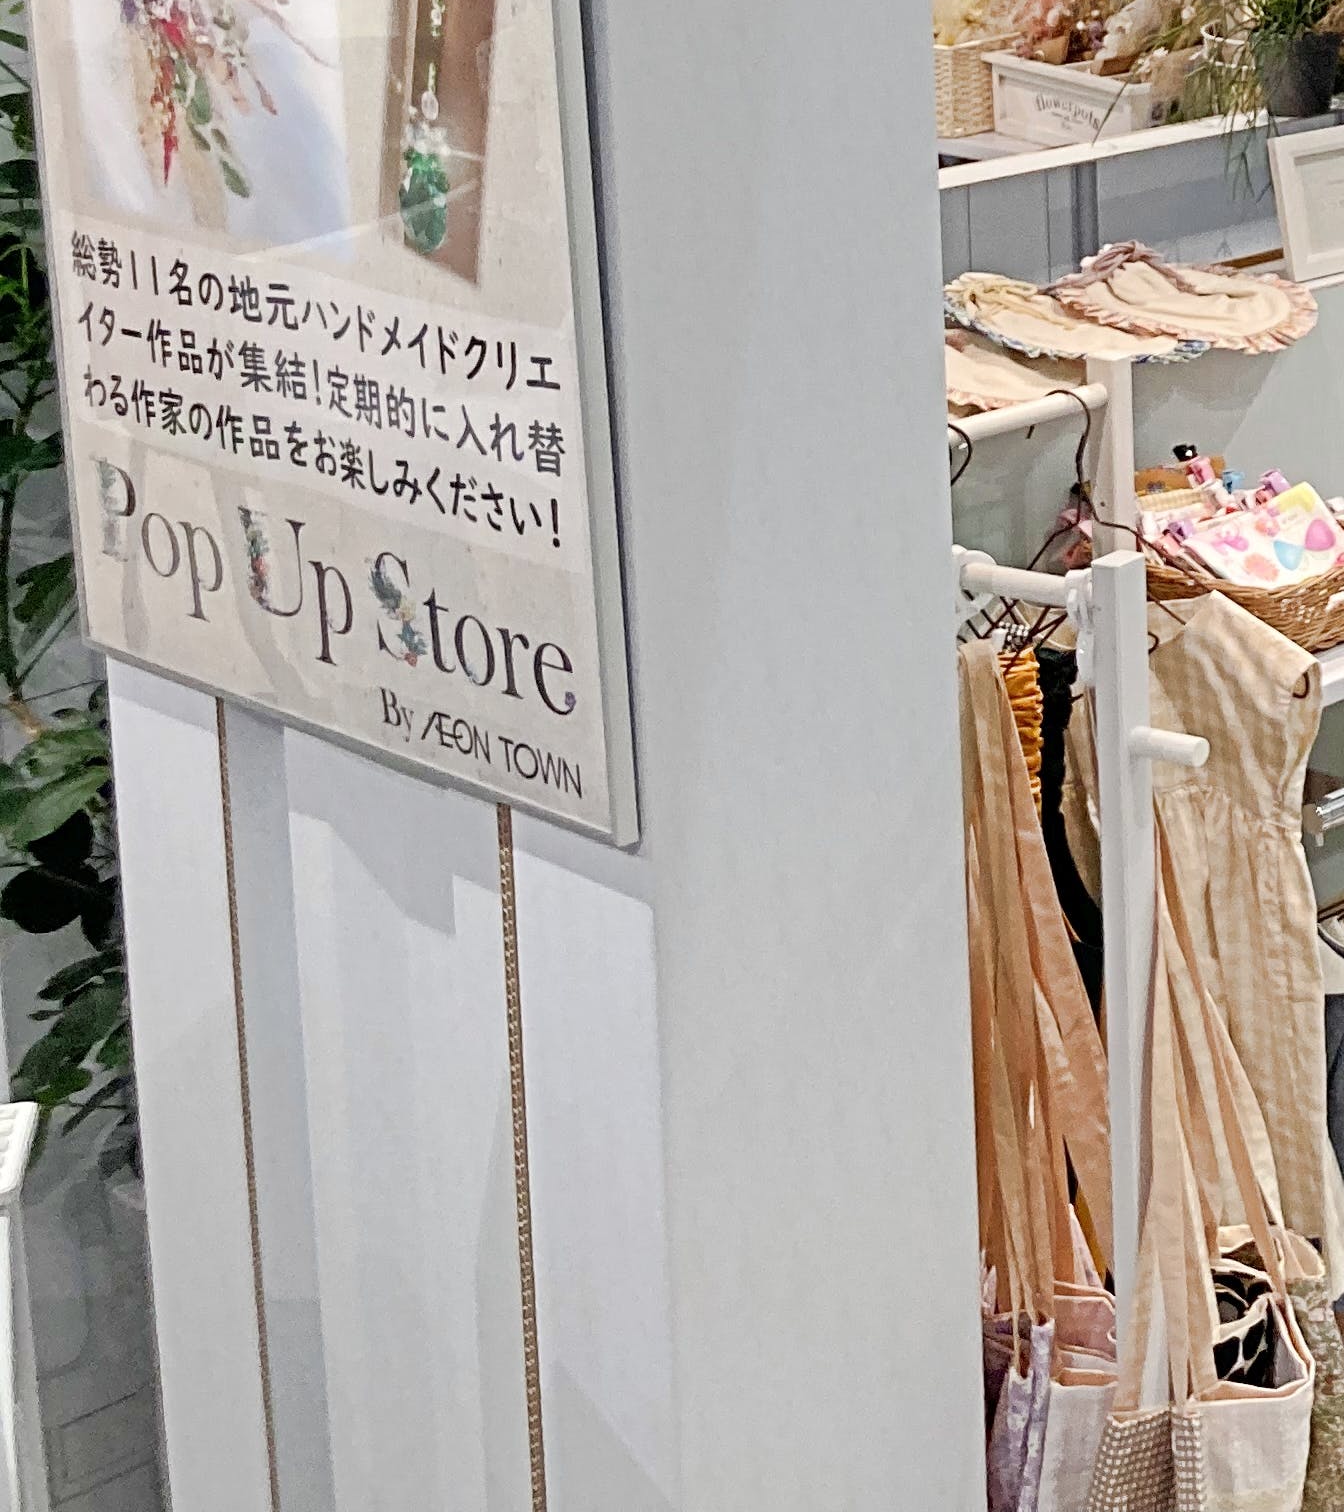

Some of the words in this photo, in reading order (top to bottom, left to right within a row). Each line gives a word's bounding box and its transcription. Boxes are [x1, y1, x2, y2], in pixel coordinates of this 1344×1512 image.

[71, 230, 562, 392] 総勢11名の地元ハンドメイドクリエ
[78, 301, 566, 477] イター作品が集結!定期的に入れ替
[83, 364, 561, 548] わる作家の作品をお楽しみください!
[91, 455, 223, 622] Pop
[238, 505, 353, 666] Up
[364, 551, 577, 716] Store
[379, 687, 415, 744] By
[497, 735, 584, 799] TOWN
